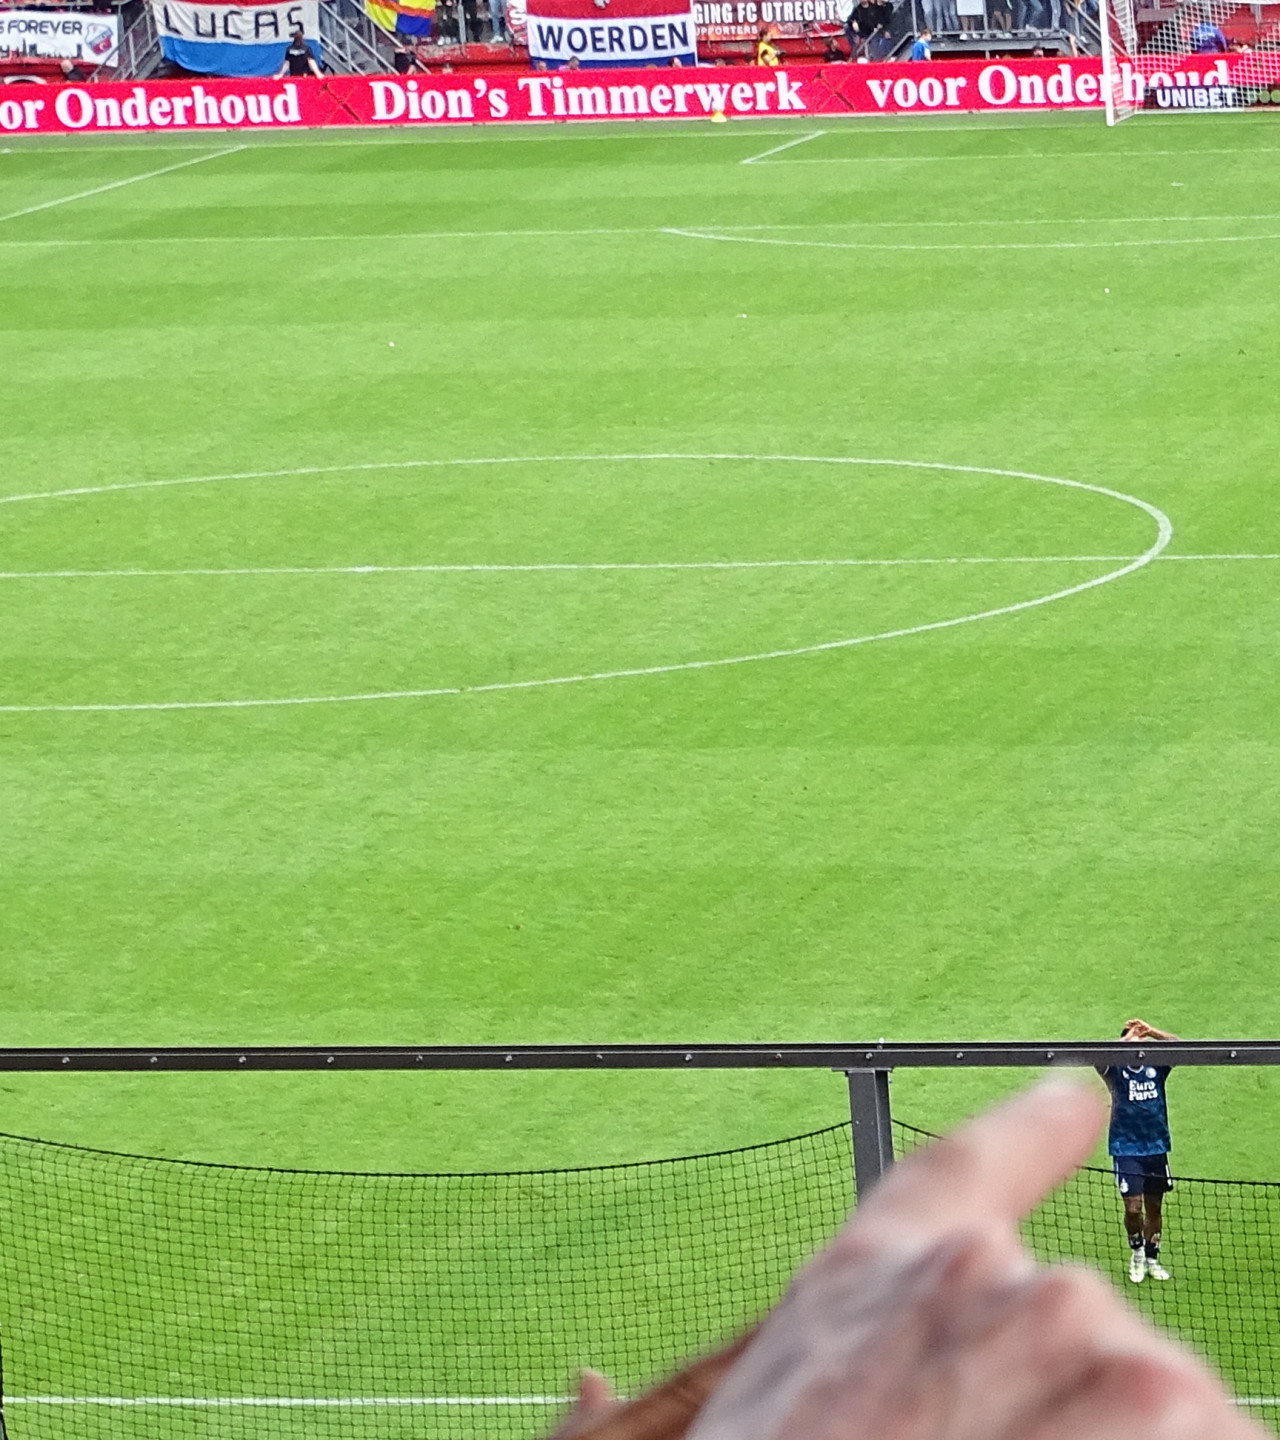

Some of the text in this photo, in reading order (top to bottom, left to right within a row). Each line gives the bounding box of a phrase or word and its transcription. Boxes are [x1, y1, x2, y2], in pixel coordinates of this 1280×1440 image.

[164, 6, 304, 39] LUCAS
[737, 2, 757, 23] FC
[762, 0, 837, 22] UTRECHT
[8, 19, 83, 34] FOREVER
[536, 21, 690, 53] WOERDEN
[55, 83, 302, 129] Onderhoud
[372, 79, 509, 121] Dion's
[518, 71, 807, 118] Timmerwerk
[867, 75, 968, 109] voor
[1156, 85, 1238, 108] UNIBET
[1128, 1080, 1156, 1091] Euro
